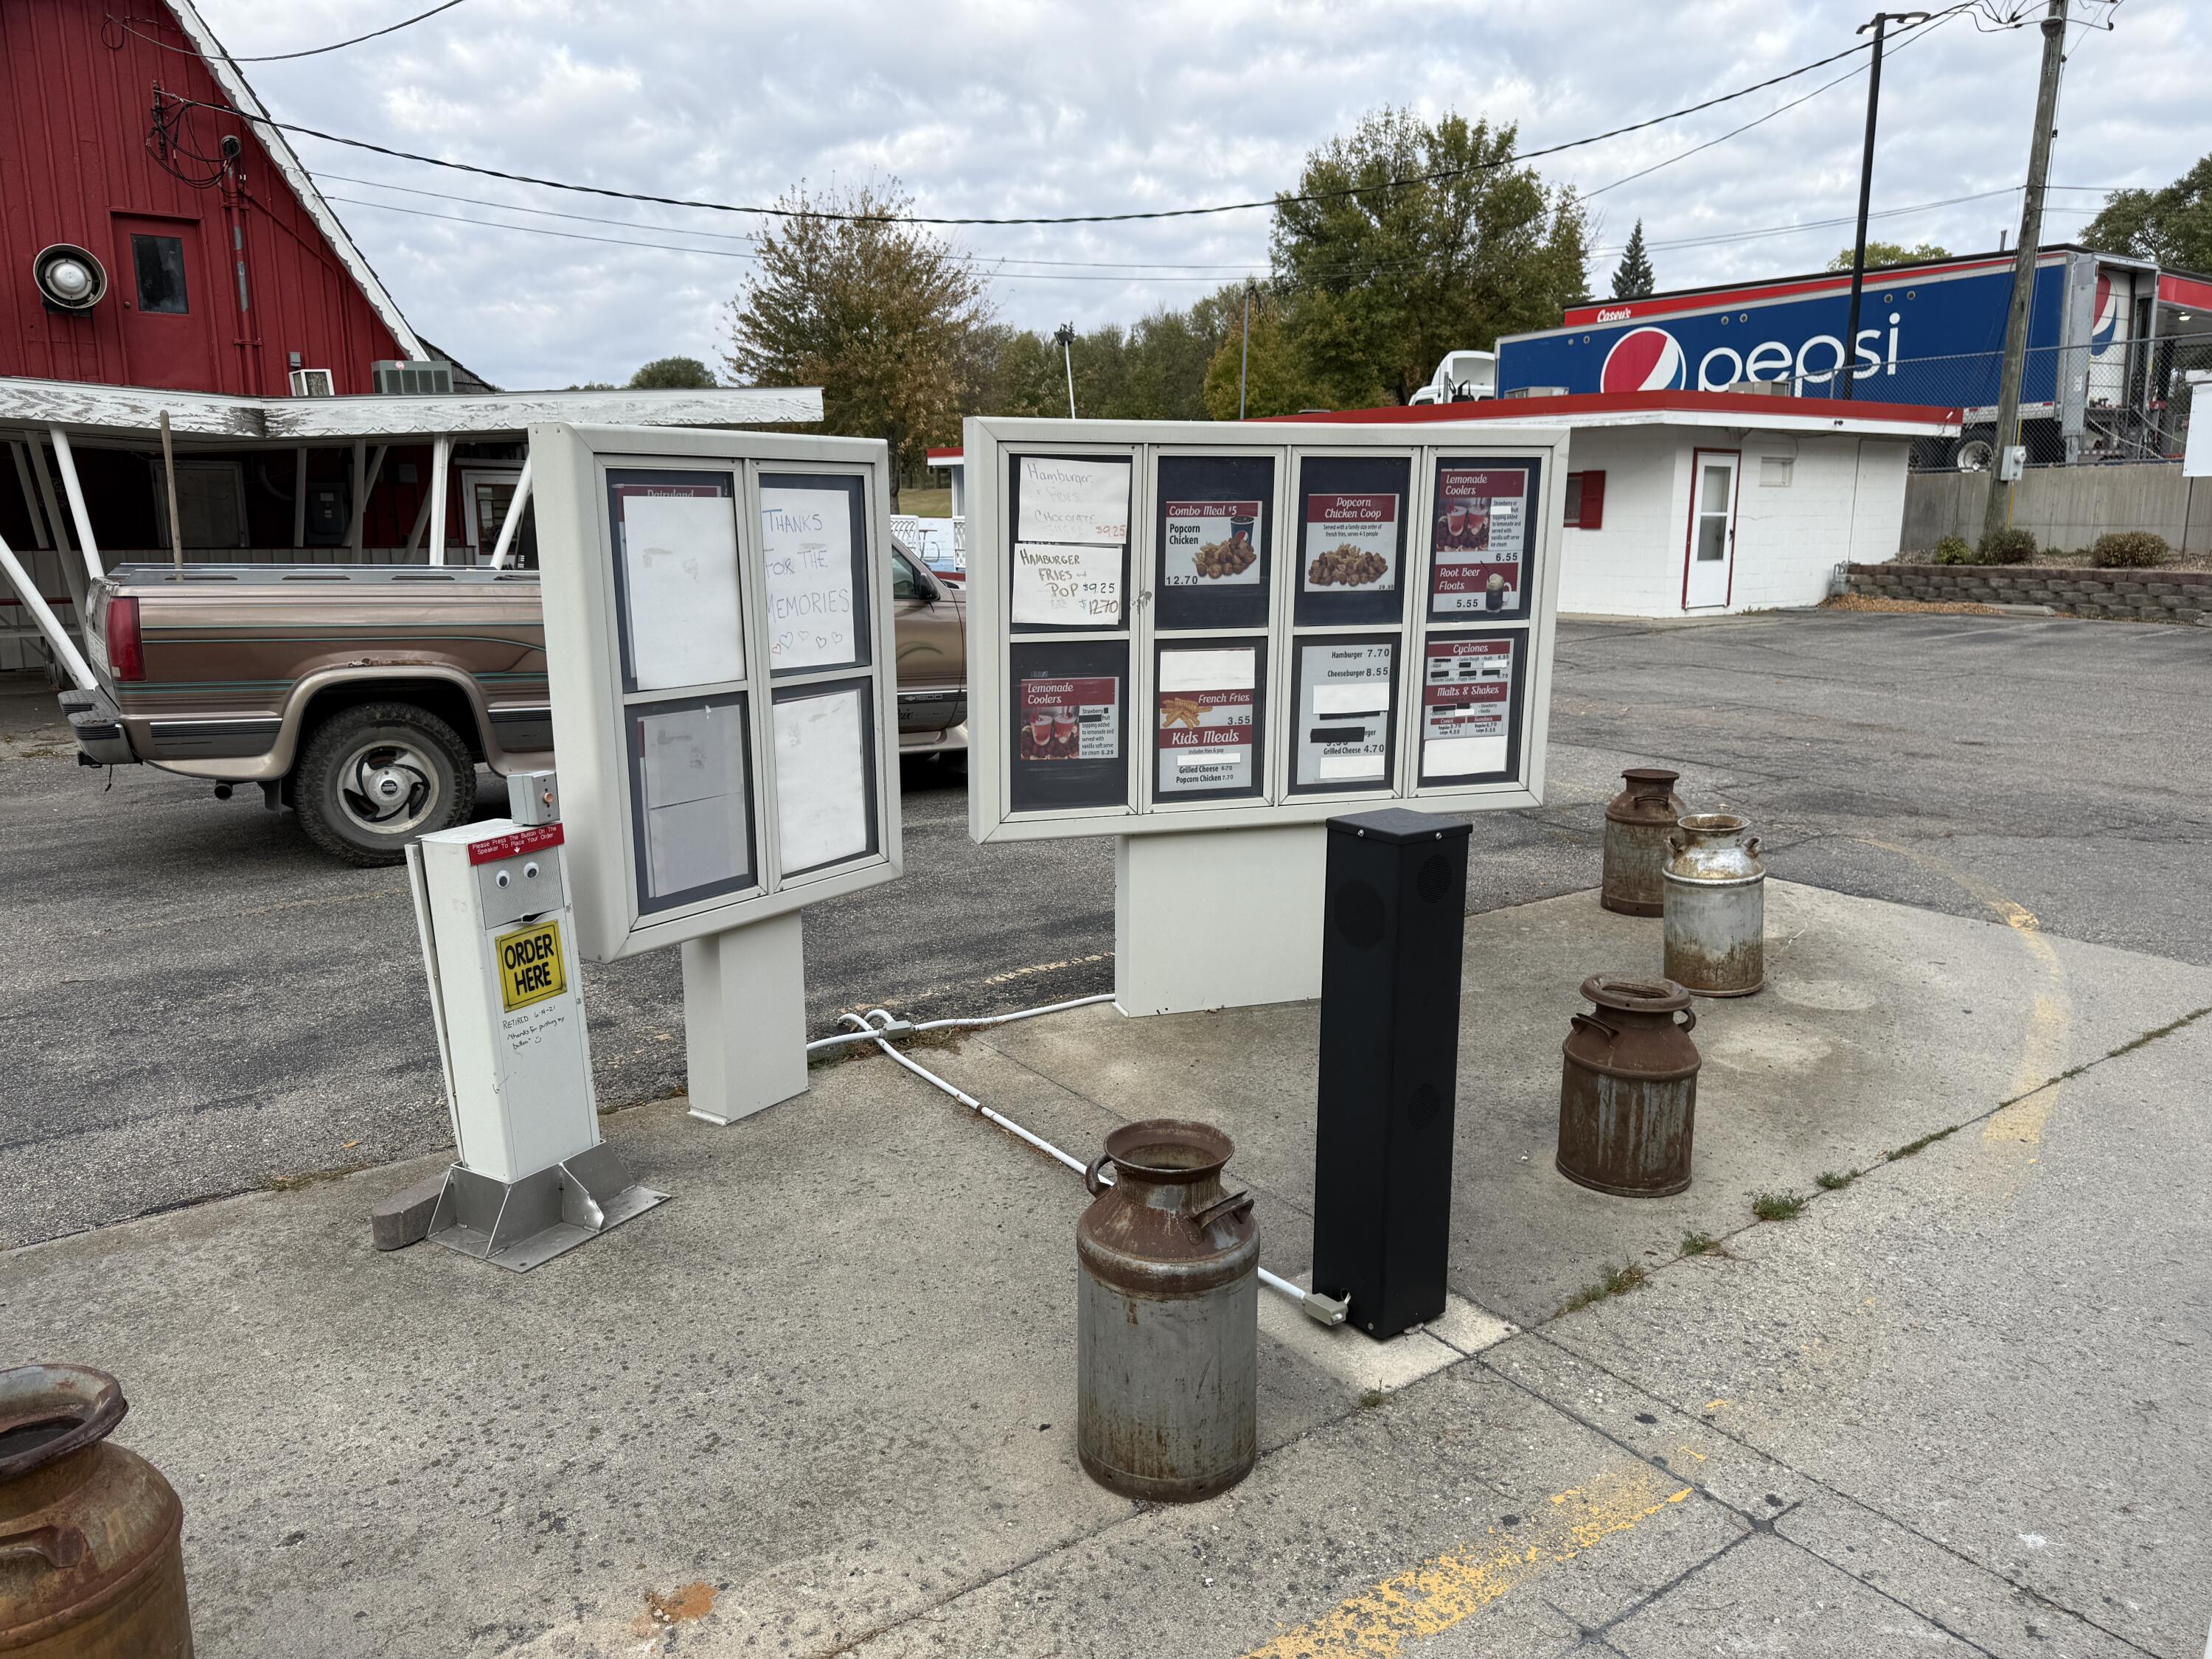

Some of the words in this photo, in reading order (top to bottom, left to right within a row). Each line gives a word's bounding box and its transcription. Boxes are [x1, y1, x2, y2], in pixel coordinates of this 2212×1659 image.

[1698, 313, 1900, 397] pepsi
[1446, 474, 1487, 484] Lemonade
[1445, 486, 1476, 495] Coolers
[1336, 497, 1371, 509] Popcorn
[1169, 506, 1200, 515] Combo
[1203, 506, 1225, 515] Meal
[1228, 506, 1237, 515] #5
[1325, 508, 1357, 518] Chicken
[1360, 509, 1382, 521] Coop
[762, 509, 822, 532] THANKS
[1169, 524, 1200, 535] Popcorn
[1169, 535, 1198, 544] Chicken
[1020, 549, 1080, 566] HAMBURGER
[1496, 552, 1517, 561] 6.55
[764, 549, 795, 578] FOR
[797, 548, 828, 569] THE
[1038, 568, 1073, 581] FRIES
[1440, 568, 1459, 577] Root
[1461, 568, 1480, 576] Beer
[1166, 576, 1198, 585] 12.70
[1439, 581, 1464, 590] Floats
[767, 588, 849, 623] MEMORIES
[1456, 599, 1478, 608] 5.55
[1332, 651, 1363, 659] Hamburger
[1368, 649, 1389, 658] 7.70
[1453, 644, 1488, 655] Cyclones
[1328, 669, 1365, 678] Cheeseburger
[1366, 667, 1388, 676] 8.55
[1028, 682, 1074, 693] Lemonade
[1437, 686, 1460, 697] Malts
[1463, 686, 1469, 695] &
[1471, 686, 1499, 695] Shakes
[1028, 694, 1062, 704] Coolers
[1198, 693, 1227, 703] French
[1229, 693, 1250, 702] Fries
[1228, 716, 1251, 725] 3.55
[1172, 731, 1199, 745] Kids
[1203, 729, 1239, 743] Meals
[1363, 744, 1384, 752] 4.70
[1176, 776, 1199, 785] Popcorn
[521, 831, 536, 839] Button
[477, 846, 498, 855] Speaker
[511, 839, 524, 847] Place
[504, 933, 554, 970] ORDER
[514, 961, 552, 996] HERE
[503, 1016, 529, 1030] RETIRED
[539, 1018, 557, 1032] pushing
